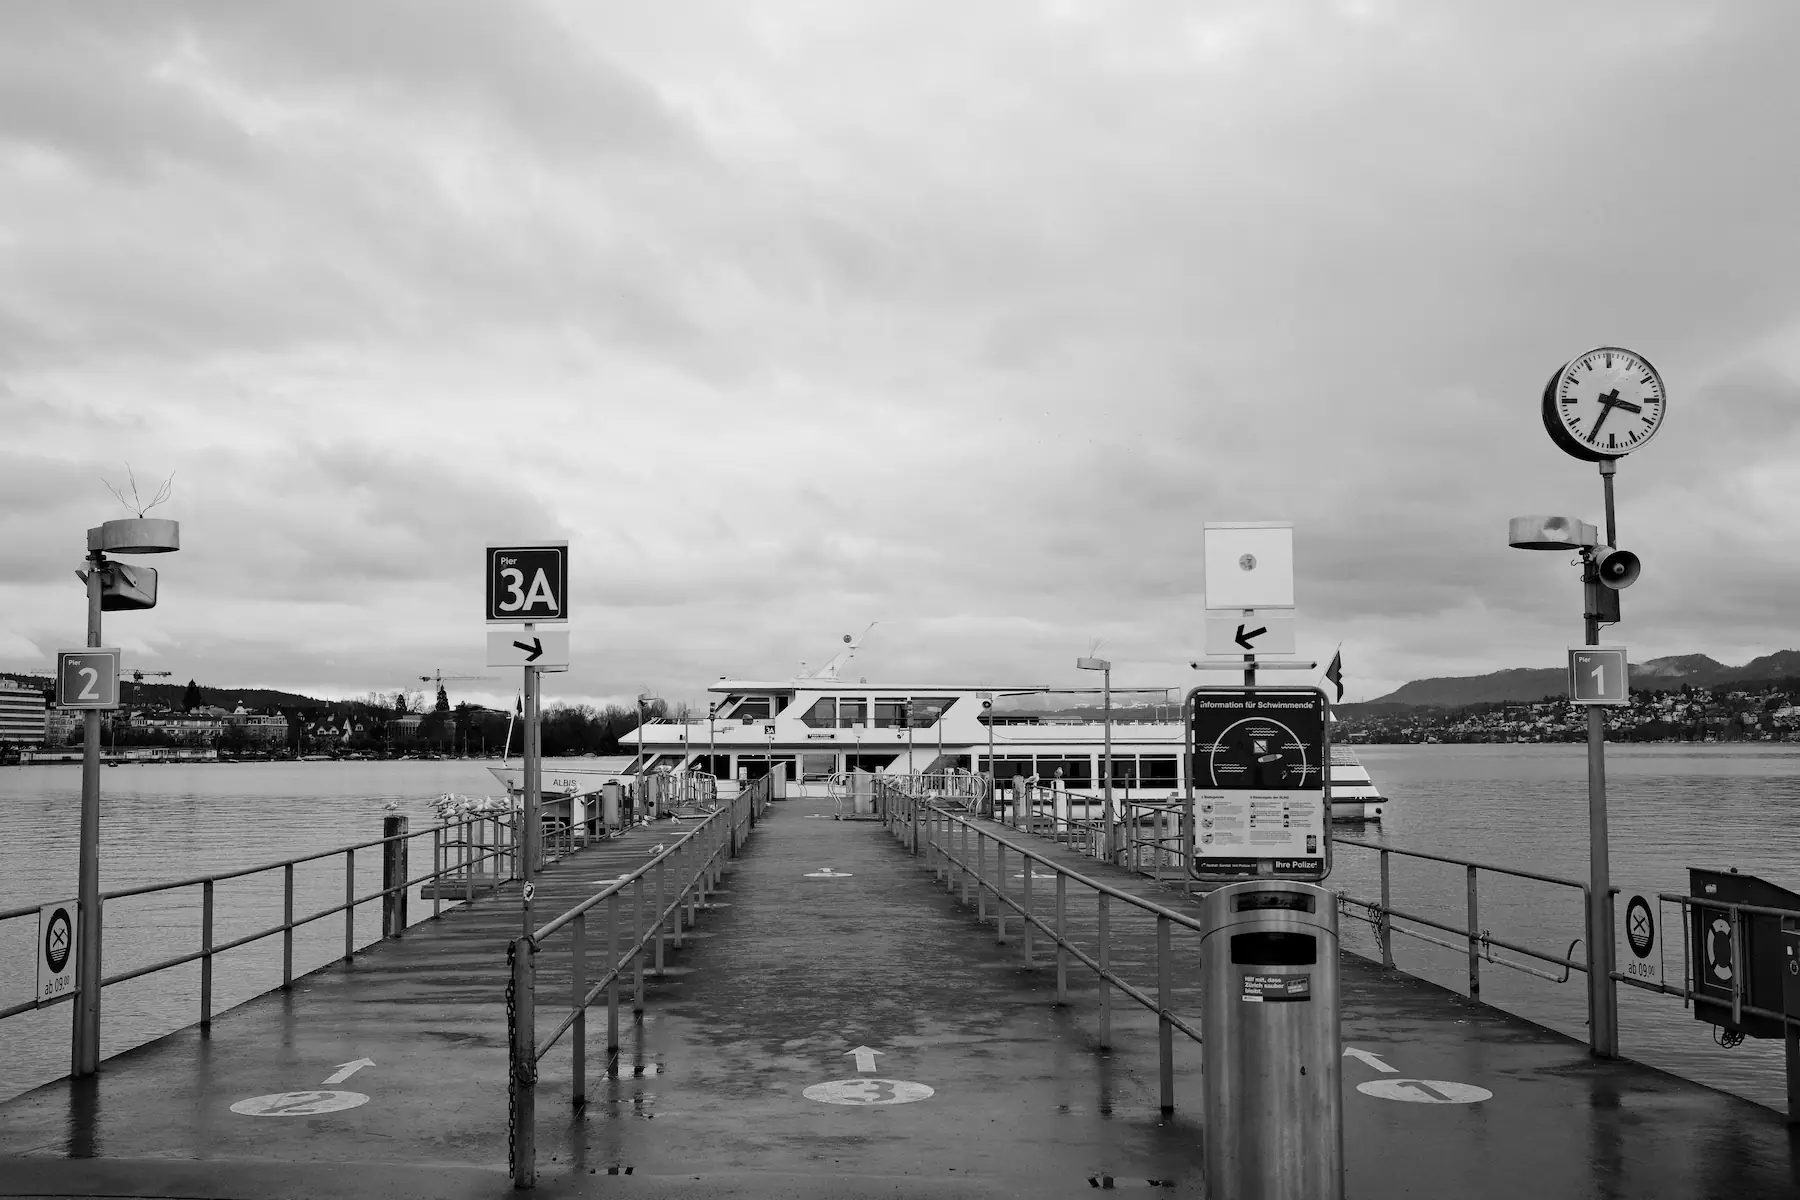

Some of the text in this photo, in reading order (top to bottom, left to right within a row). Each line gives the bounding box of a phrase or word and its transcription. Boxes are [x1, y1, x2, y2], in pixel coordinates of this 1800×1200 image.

[500, 557, 517, 565] Pier
[499, 567, 559, 611] 3A
[77, 667, 100, 700] 2
[1591, 664, 1605, 696] 1
[1245, 700, 1256, 709] für
[765, 726, 775, 734] 3A
[553, 778, 577, 787] ALBIS
[1275, 860, 1291, 869] Ihre
[1628, 961, 1637, 975] ab
[45, 980, 53, 995] ab
[842, 1080, 897, 1102] 3
[1395, 1081, 1453, 1101] 1
[257, 1092, 337, 1114] 2
